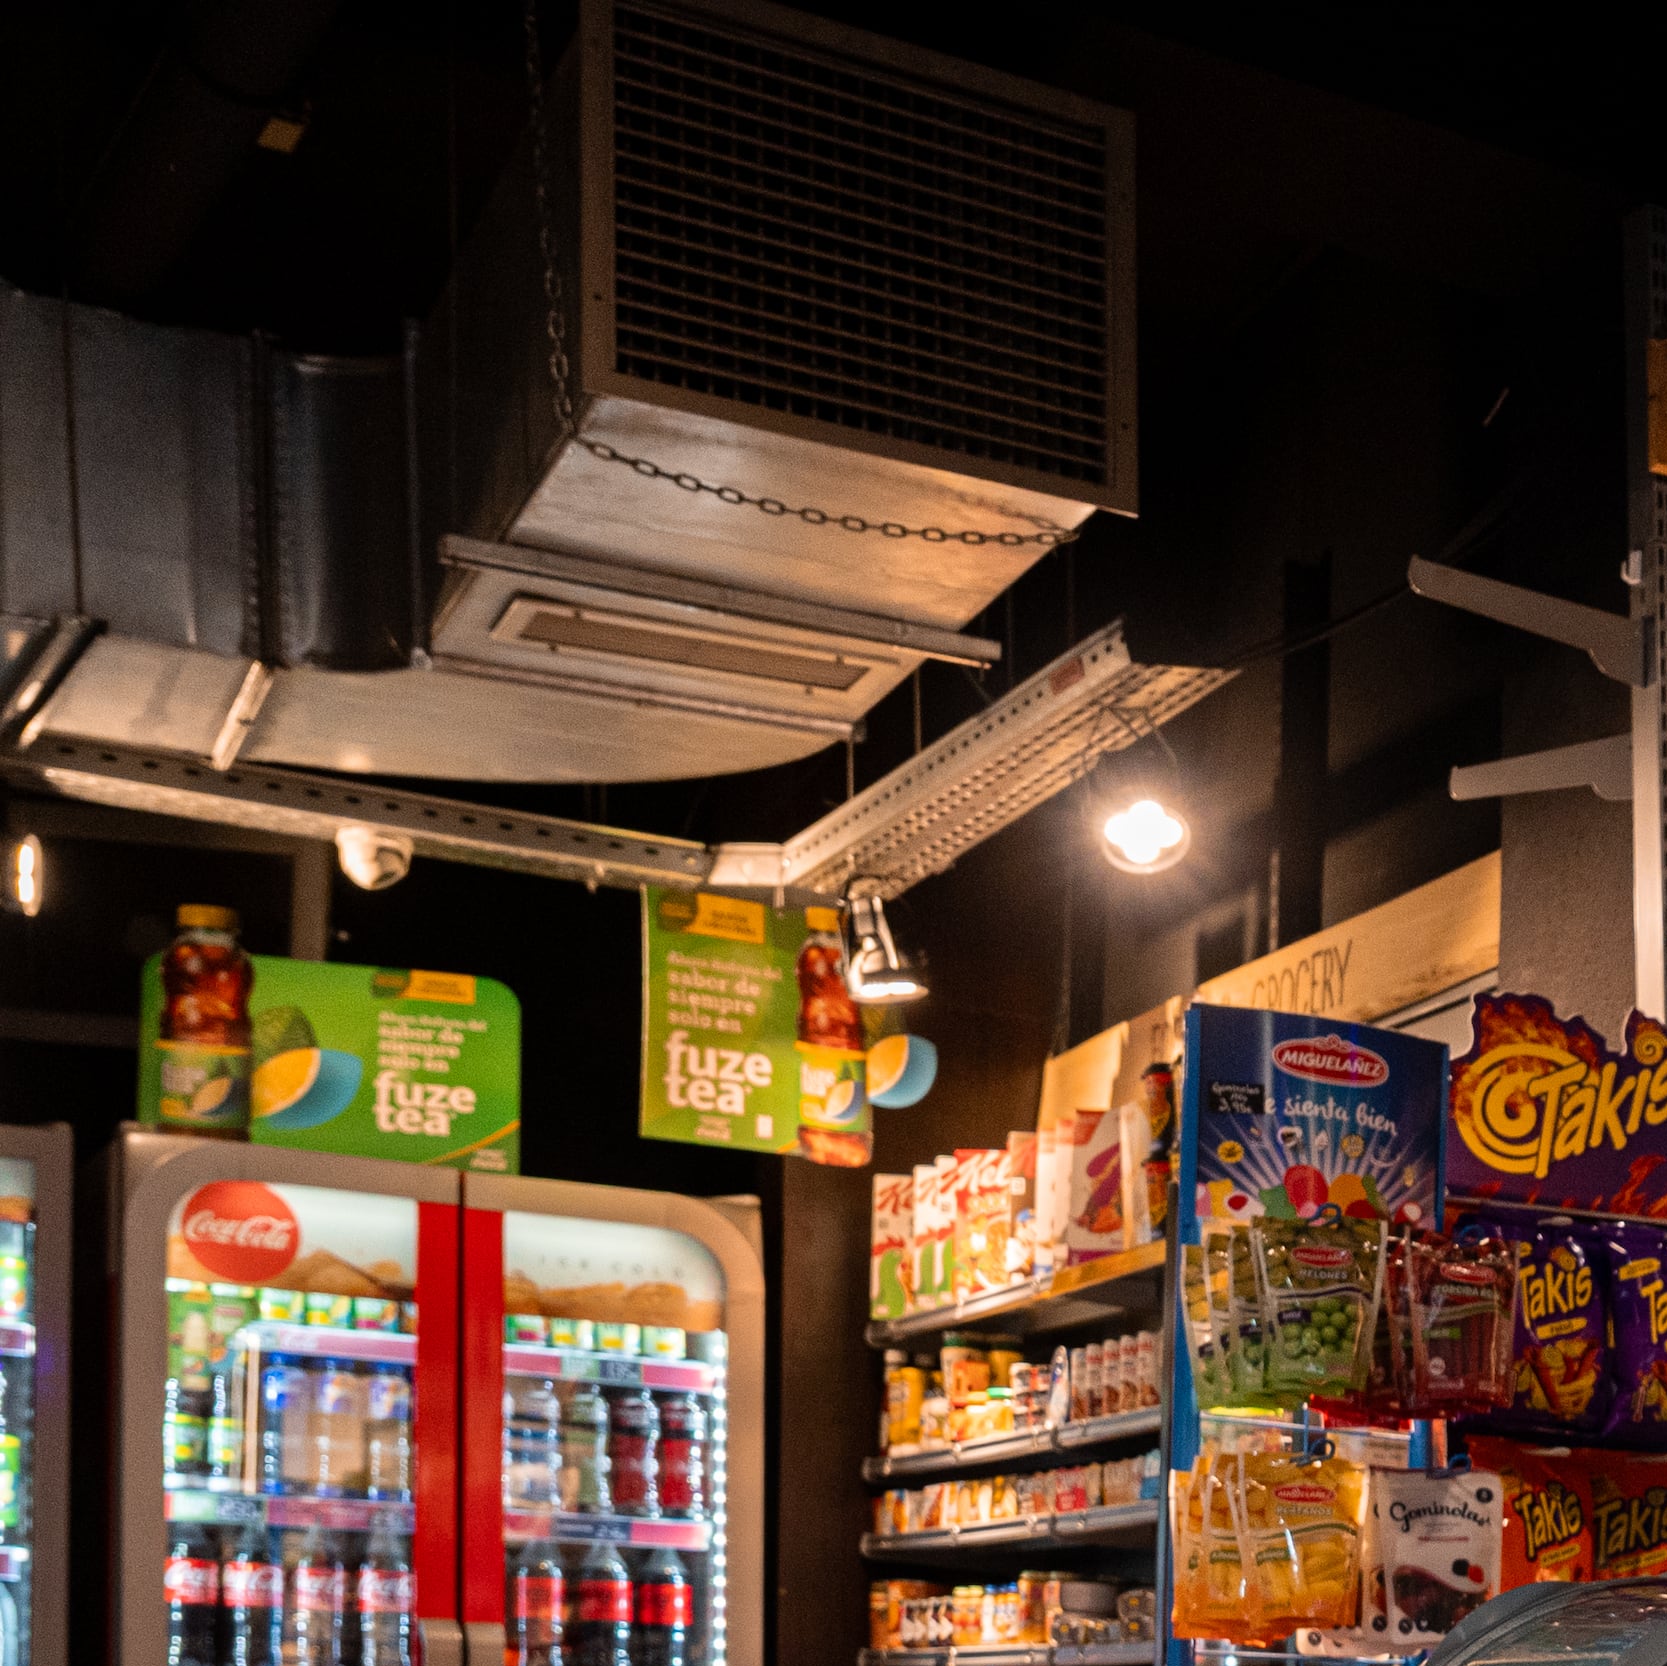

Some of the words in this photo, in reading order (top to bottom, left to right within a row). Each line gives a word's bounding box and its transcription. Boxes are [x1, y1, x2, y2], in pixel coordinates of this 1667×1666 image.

[1252, 939, 1353, 1016] GROCERY
[665, 1029, 773, 1087] fuze
[1280, 1050, 1382, 1079] MIGUELAÑEZ
[373, 1069, 477, 1115] fuze
[665, 1074, 746, 1116] tea
[373, 1104, 451, 1138] tea
[1283, 1094, 1349, 1121] sienta
[1355, 1102, 1398, 1137] bien
[183, 1210, 295, 1253] Coca-Cola
[1520, 1262, 1593, 1330] Takis
[1390, 1501, 1492, 1533] Gominolas
[1514, 1491, 1583, 1560] Takis
